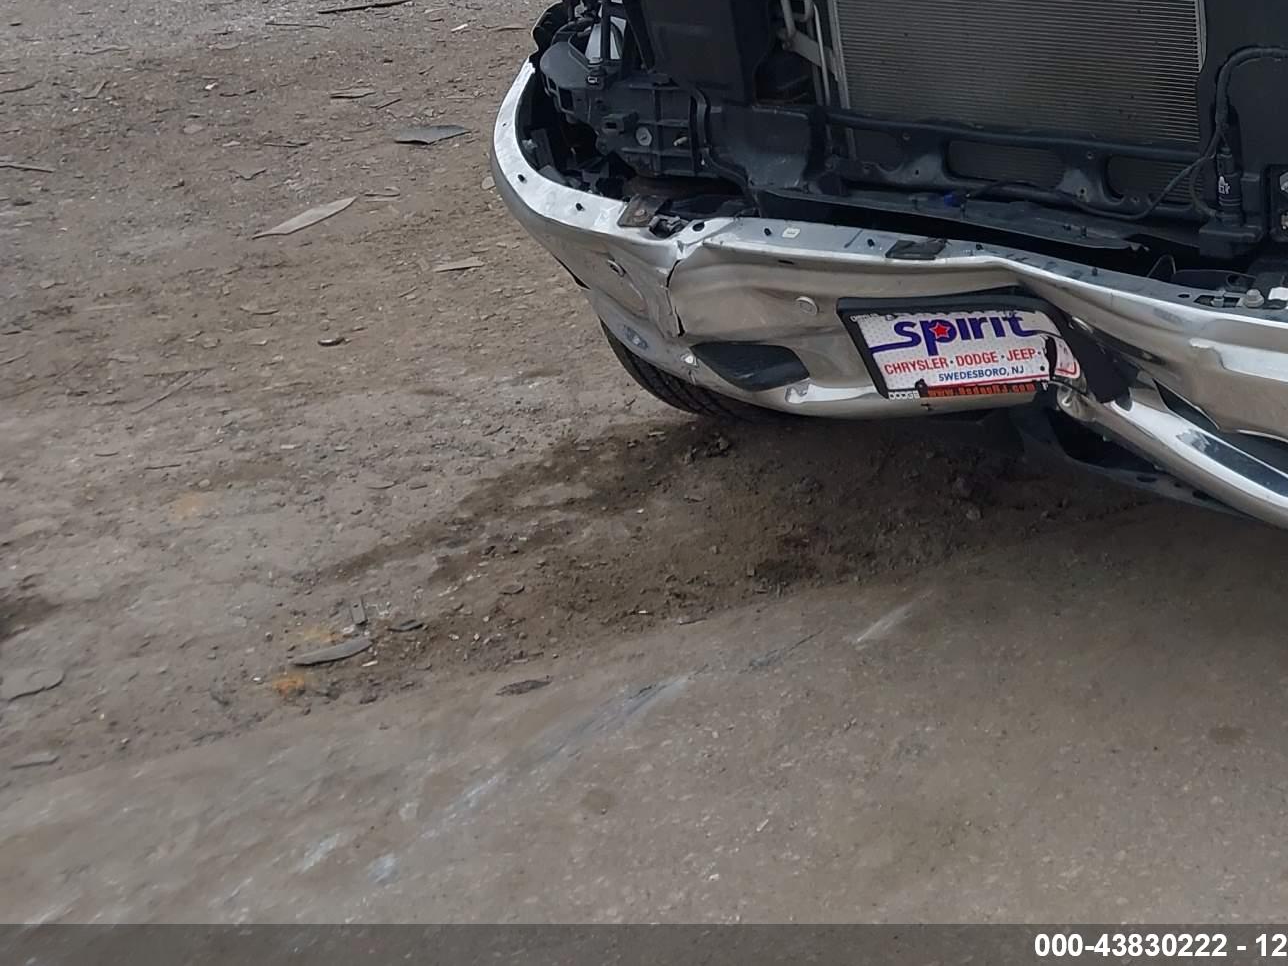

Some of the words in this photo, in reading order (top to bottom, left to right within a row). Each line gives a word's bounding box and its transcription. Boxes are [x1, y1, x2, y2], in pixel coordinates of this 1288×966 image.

[870, 313, 1046, 356] spirit
[884, 357, 949, 375] CHRYSLER
[956, 350, 999, 367] DODGE
[1006, 347, 1036, 362] JEEP
[938, 366, 1010, 383] SWEDESBORO,
[1011, 365, 1025, 375] NJ
